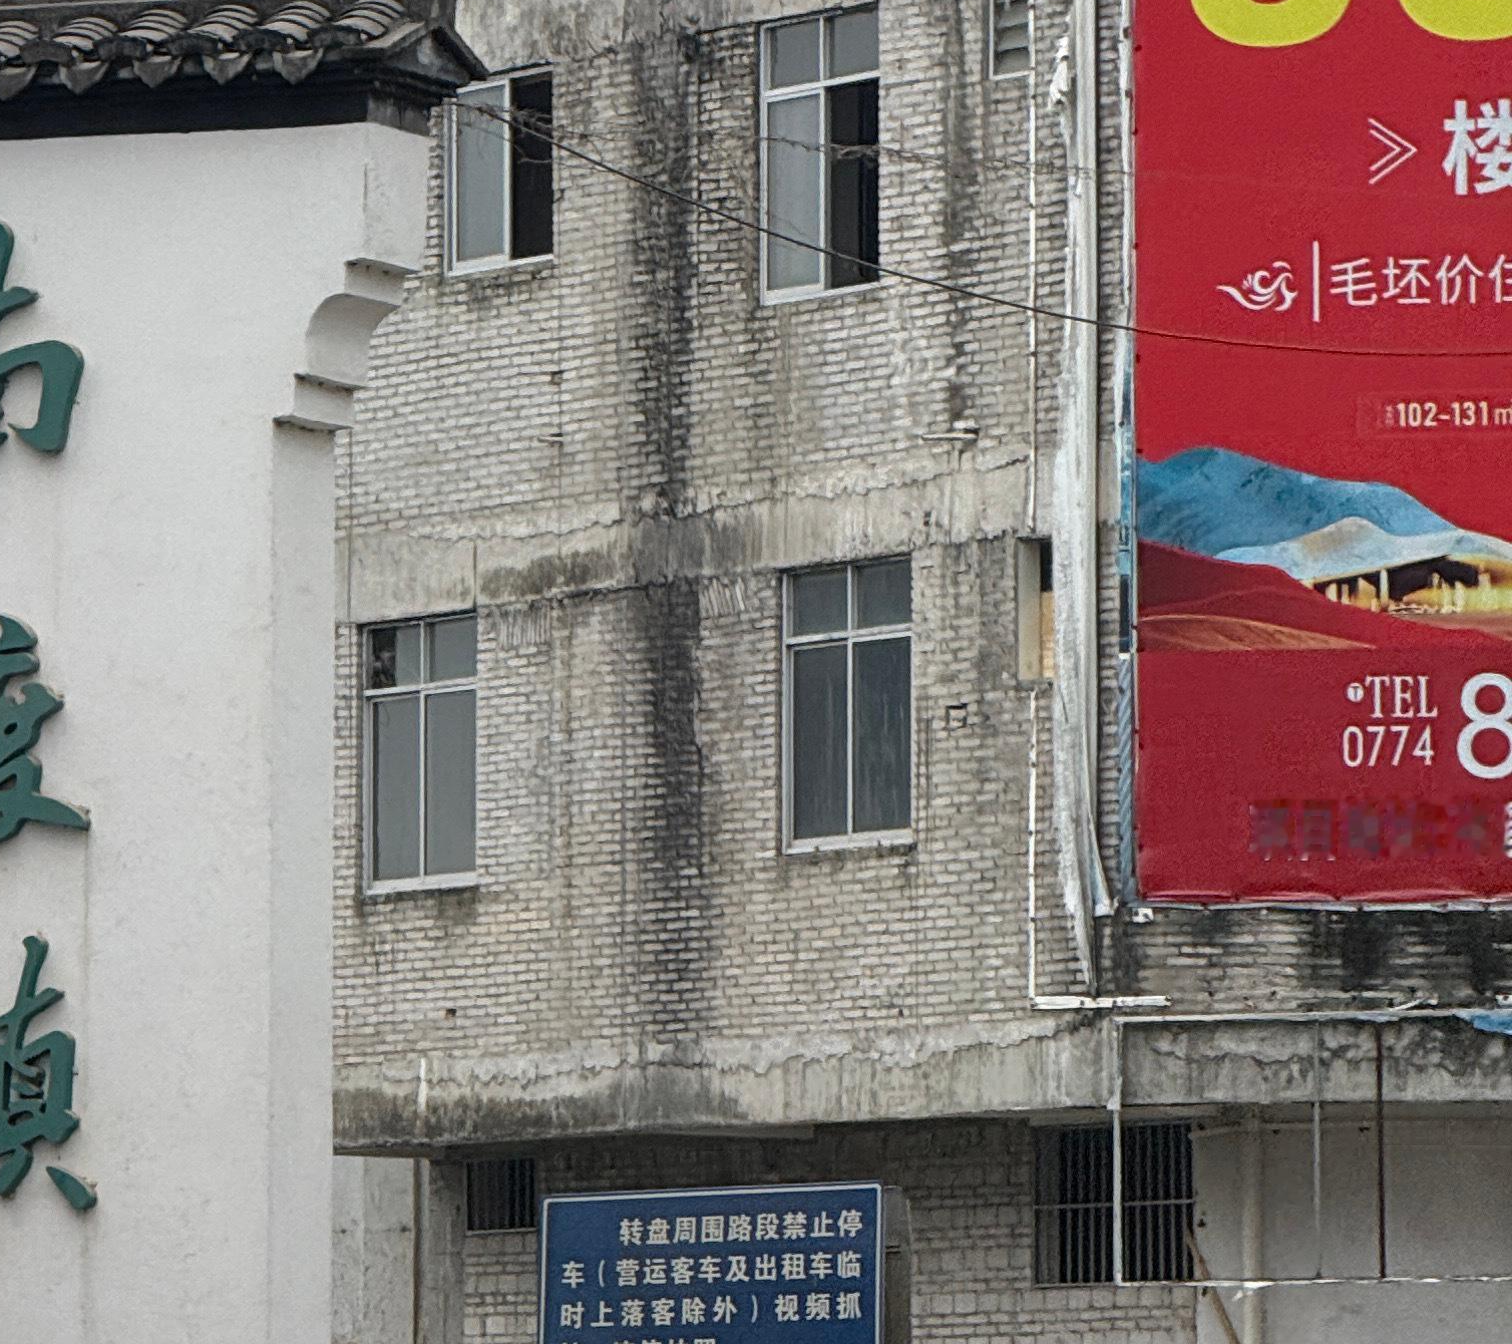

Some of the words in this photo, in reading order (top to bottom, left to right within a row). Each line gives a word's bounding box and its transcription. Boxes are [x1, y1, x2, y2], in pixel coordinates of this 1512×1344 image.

[1441, 98, 1512, 196] 楼
[1364, 674, 1438, 718] TEL
[1342, 723, 1435, 768] 0774
[618, 1208, 864, 1247] 转盘周围路段禁止停
